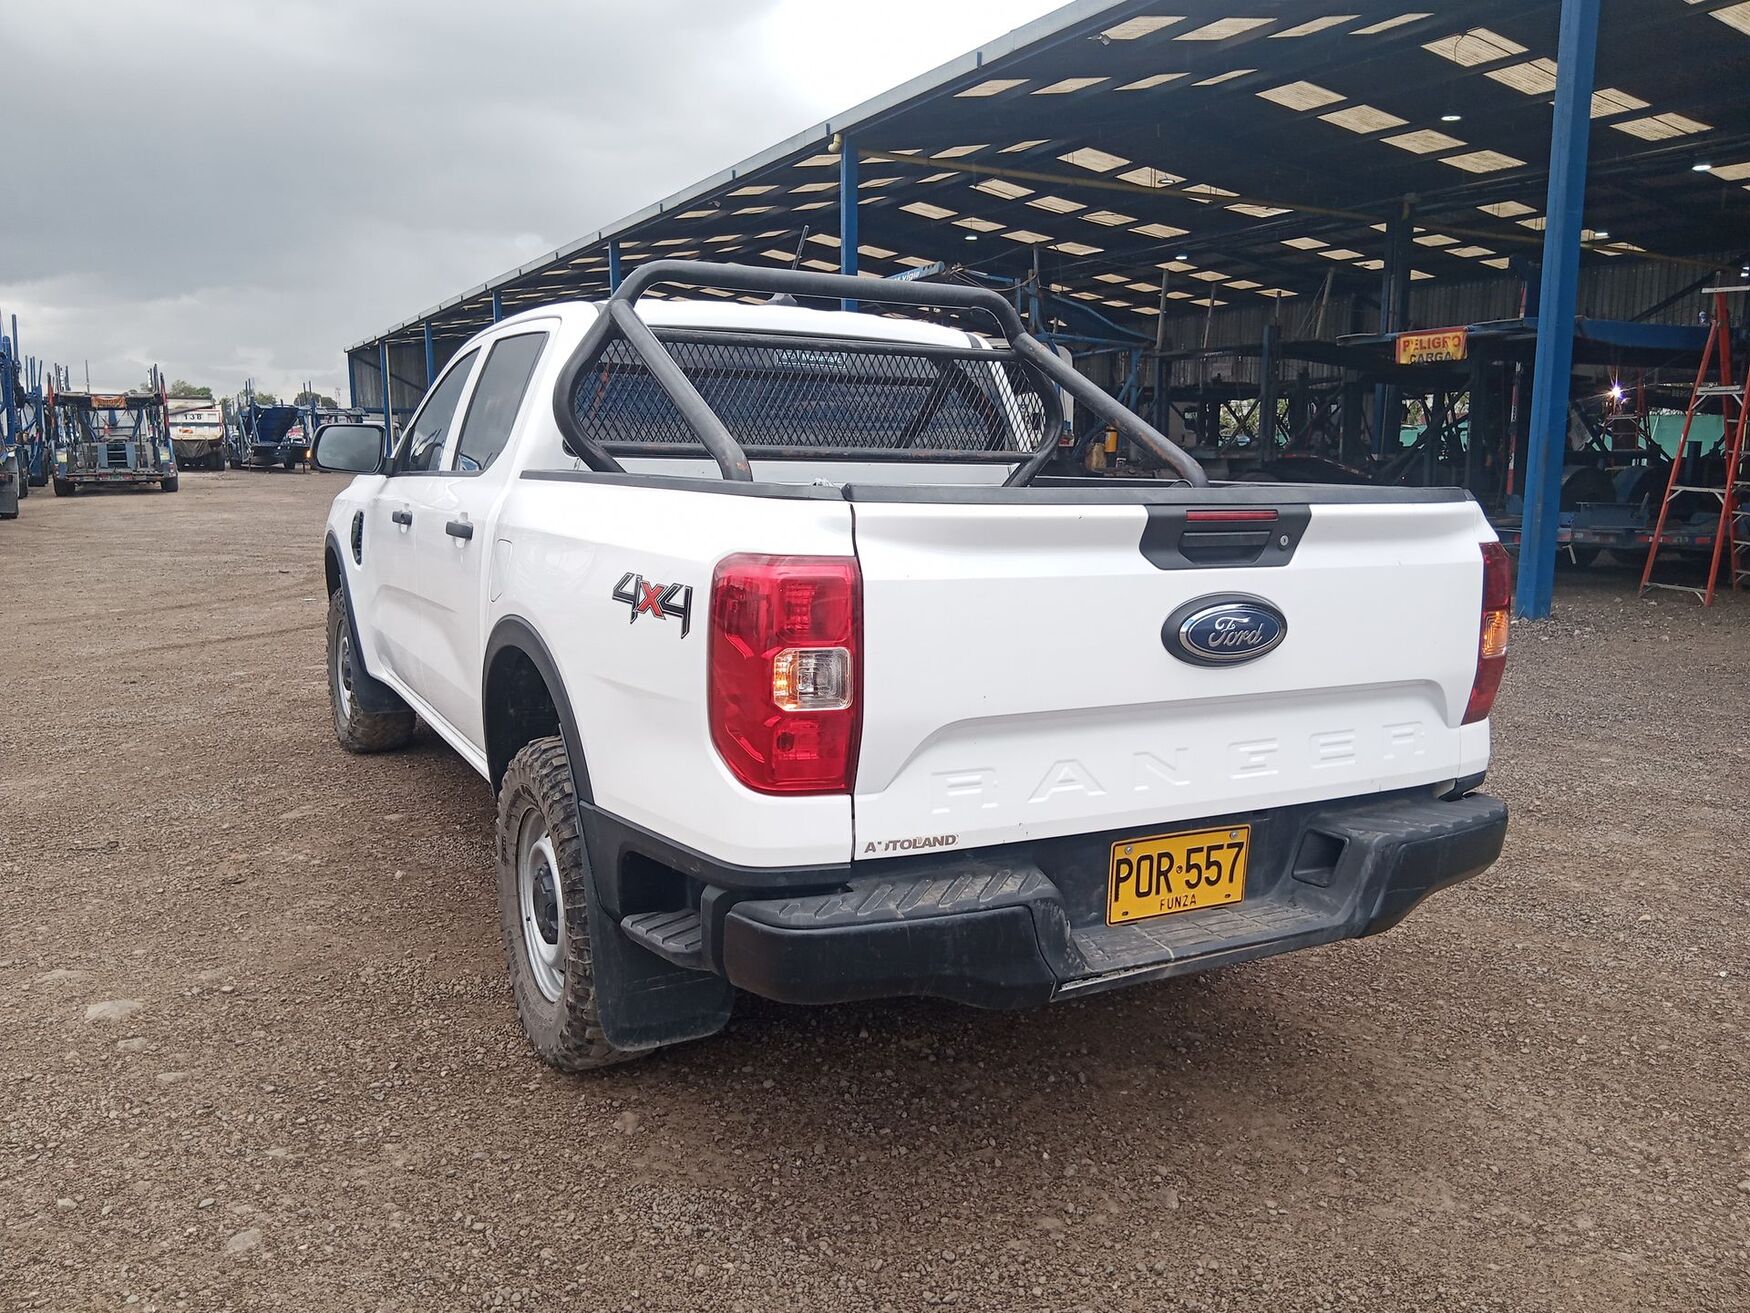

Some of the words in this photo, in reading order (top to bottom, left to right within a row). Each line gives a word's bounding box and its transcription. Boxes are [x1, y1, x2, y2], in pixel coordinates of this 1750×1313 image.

[1207, 616, 1265, 648] Ford
[931, 720, 1425, 815] RANGER
[1159, 893, 1197, 911] FUNZA
